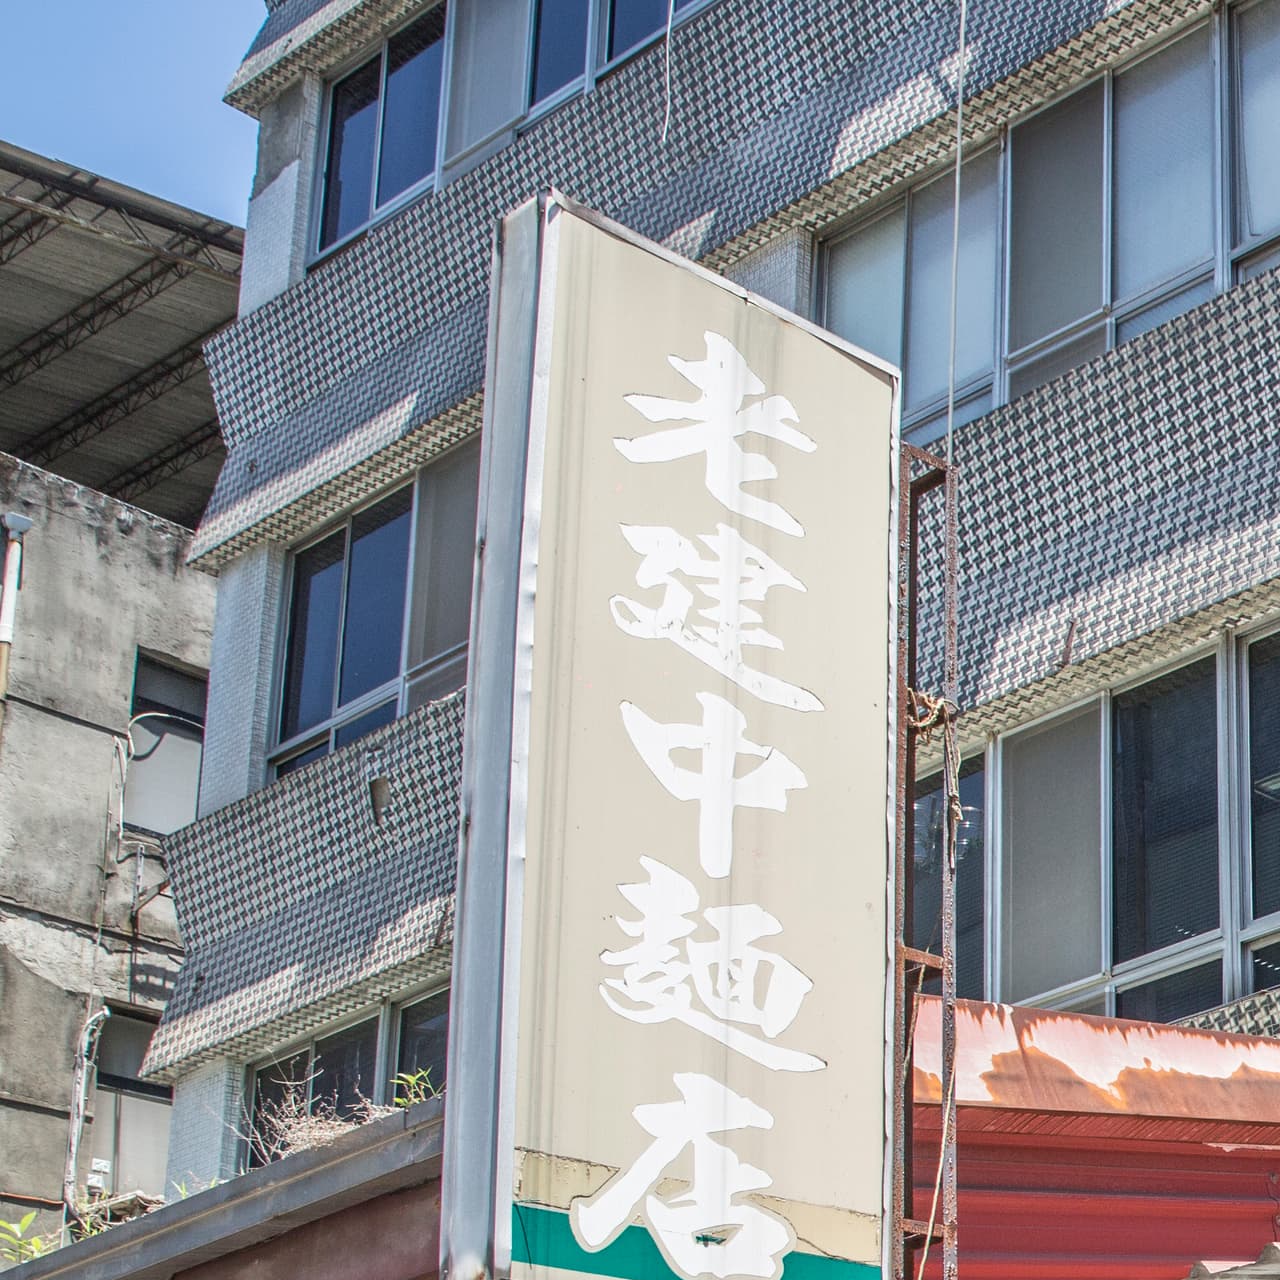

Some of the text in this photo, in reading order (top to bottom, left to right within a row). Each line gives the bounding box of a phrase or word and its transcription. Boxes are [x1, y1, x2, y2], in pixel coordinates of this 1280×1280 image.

[572, 331, 828, 1280] 老建中麵店
